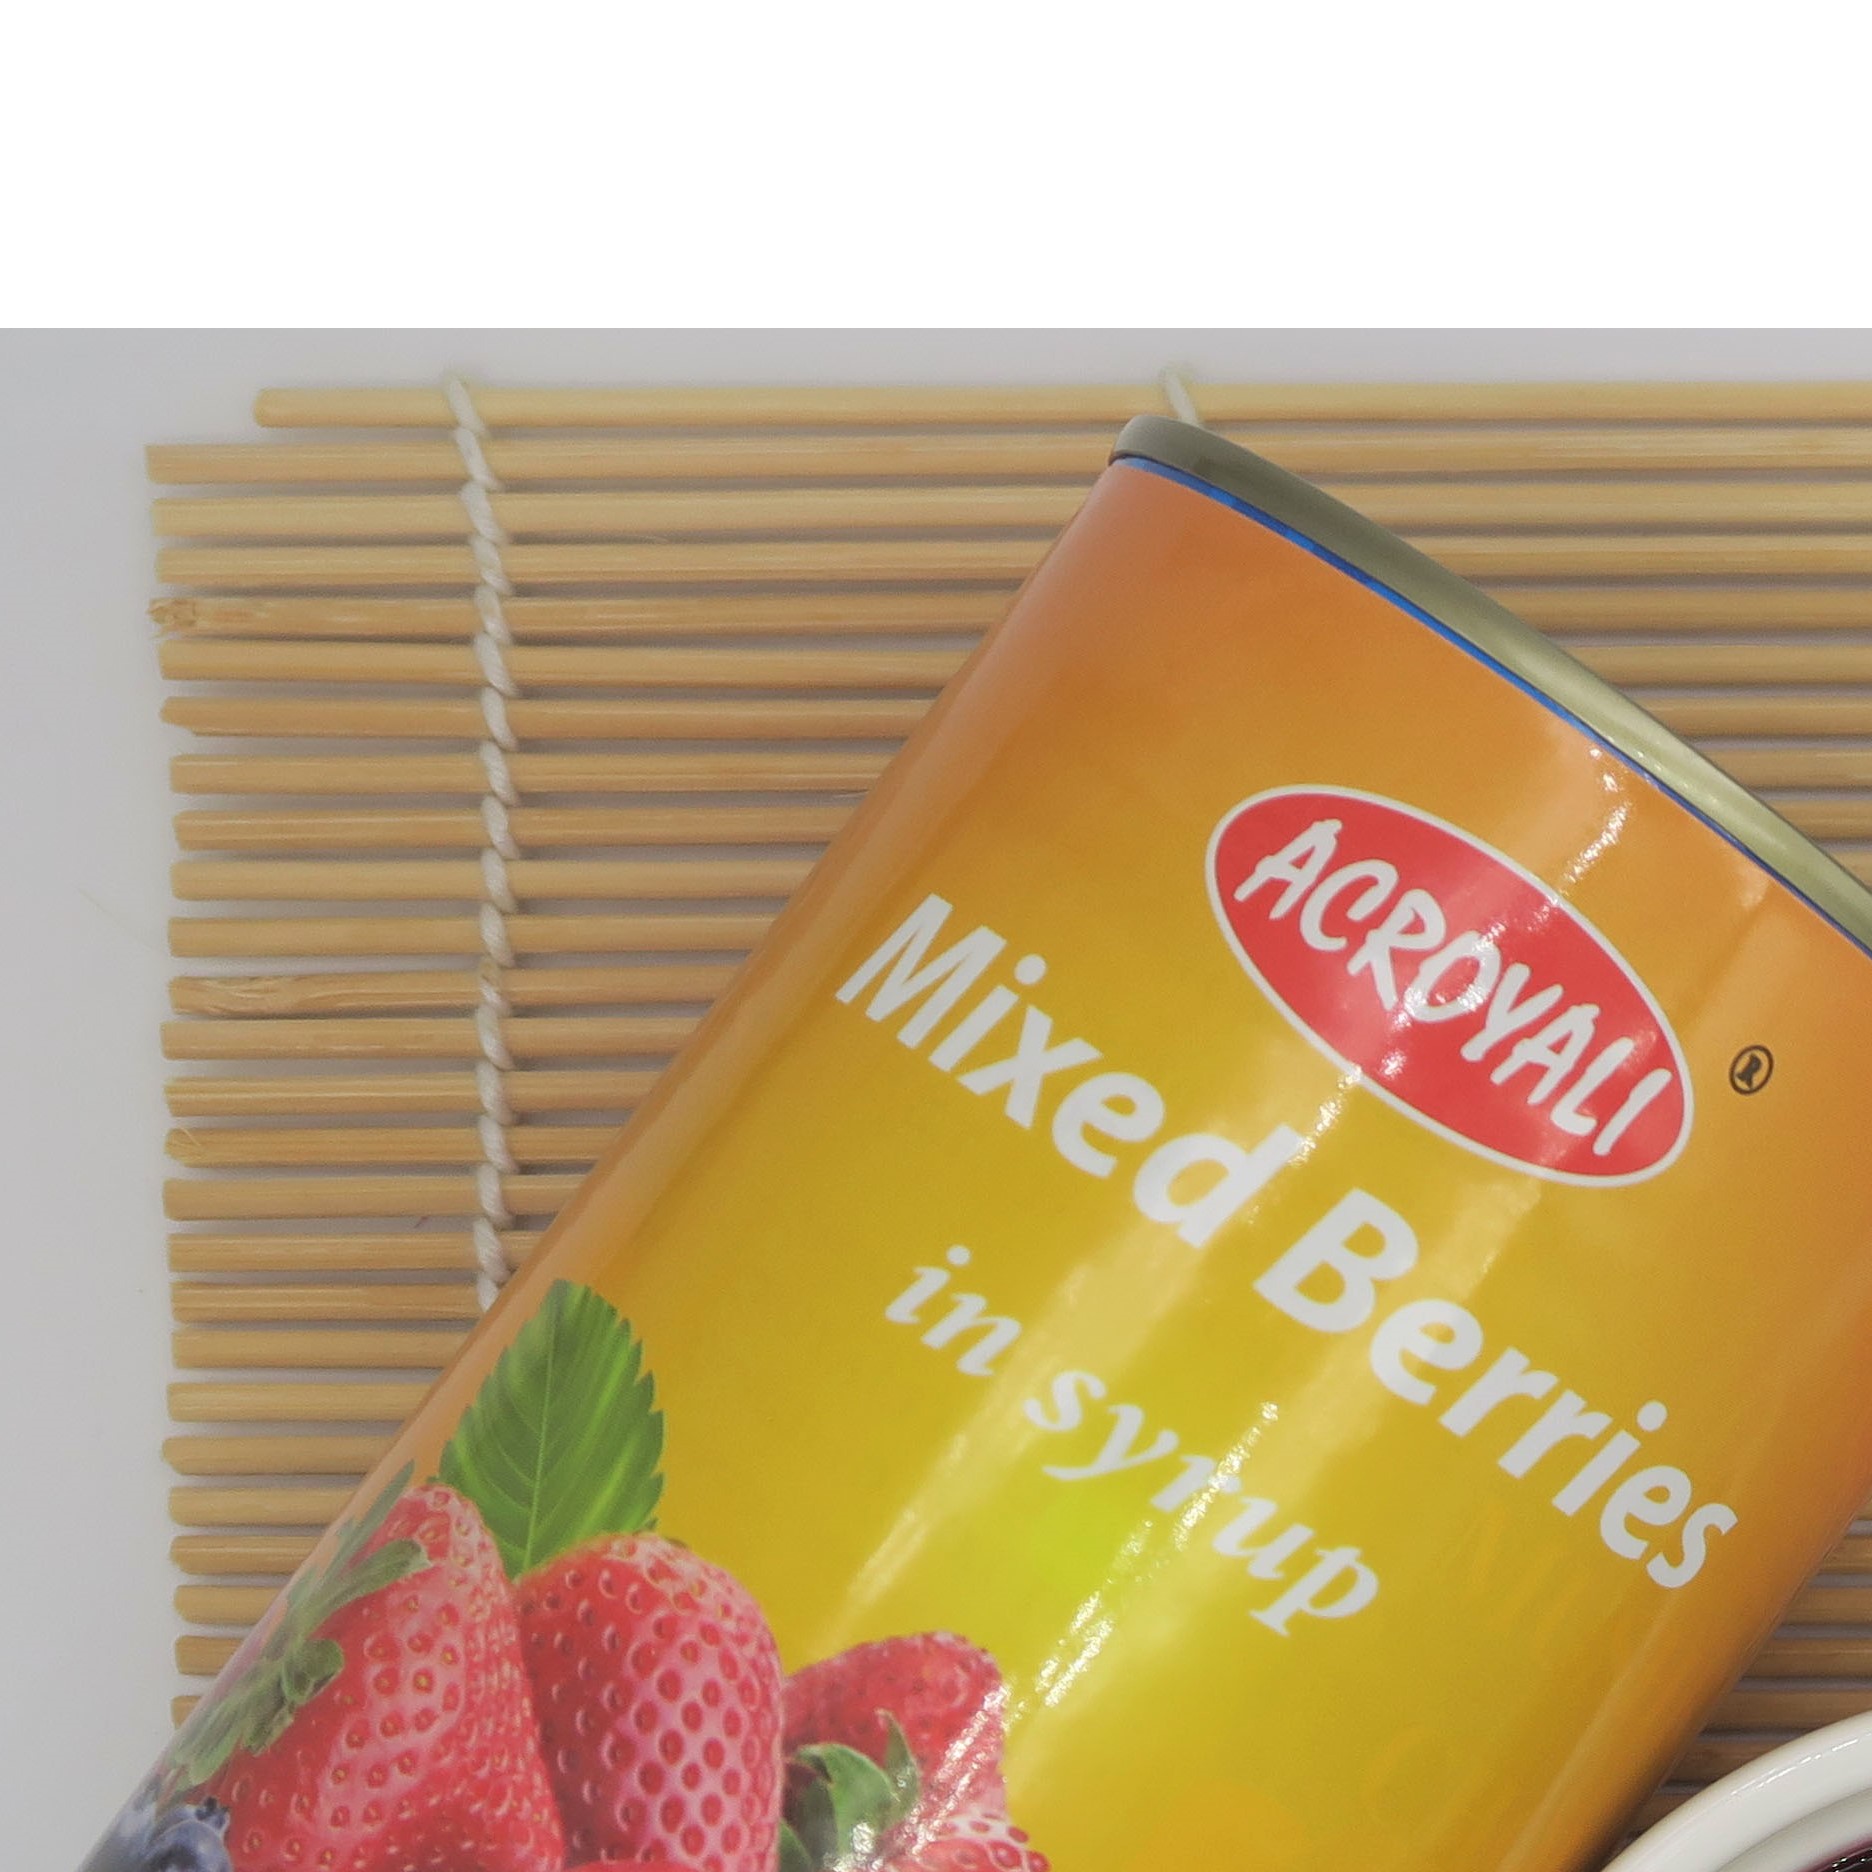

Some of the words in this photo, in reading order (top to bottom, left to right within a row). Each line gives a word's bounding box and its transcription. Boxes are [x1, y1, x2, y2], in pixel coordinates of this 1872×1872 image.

[1236, 818, 1671, 1156] ACROYALI
[835, 894, 1303, 1246] Mixed
[1253, 1188, 1737, 1588] Berries
[884, 1246, 1023, 1377] in
[1025, 1370, 1379, 1635] syrup
